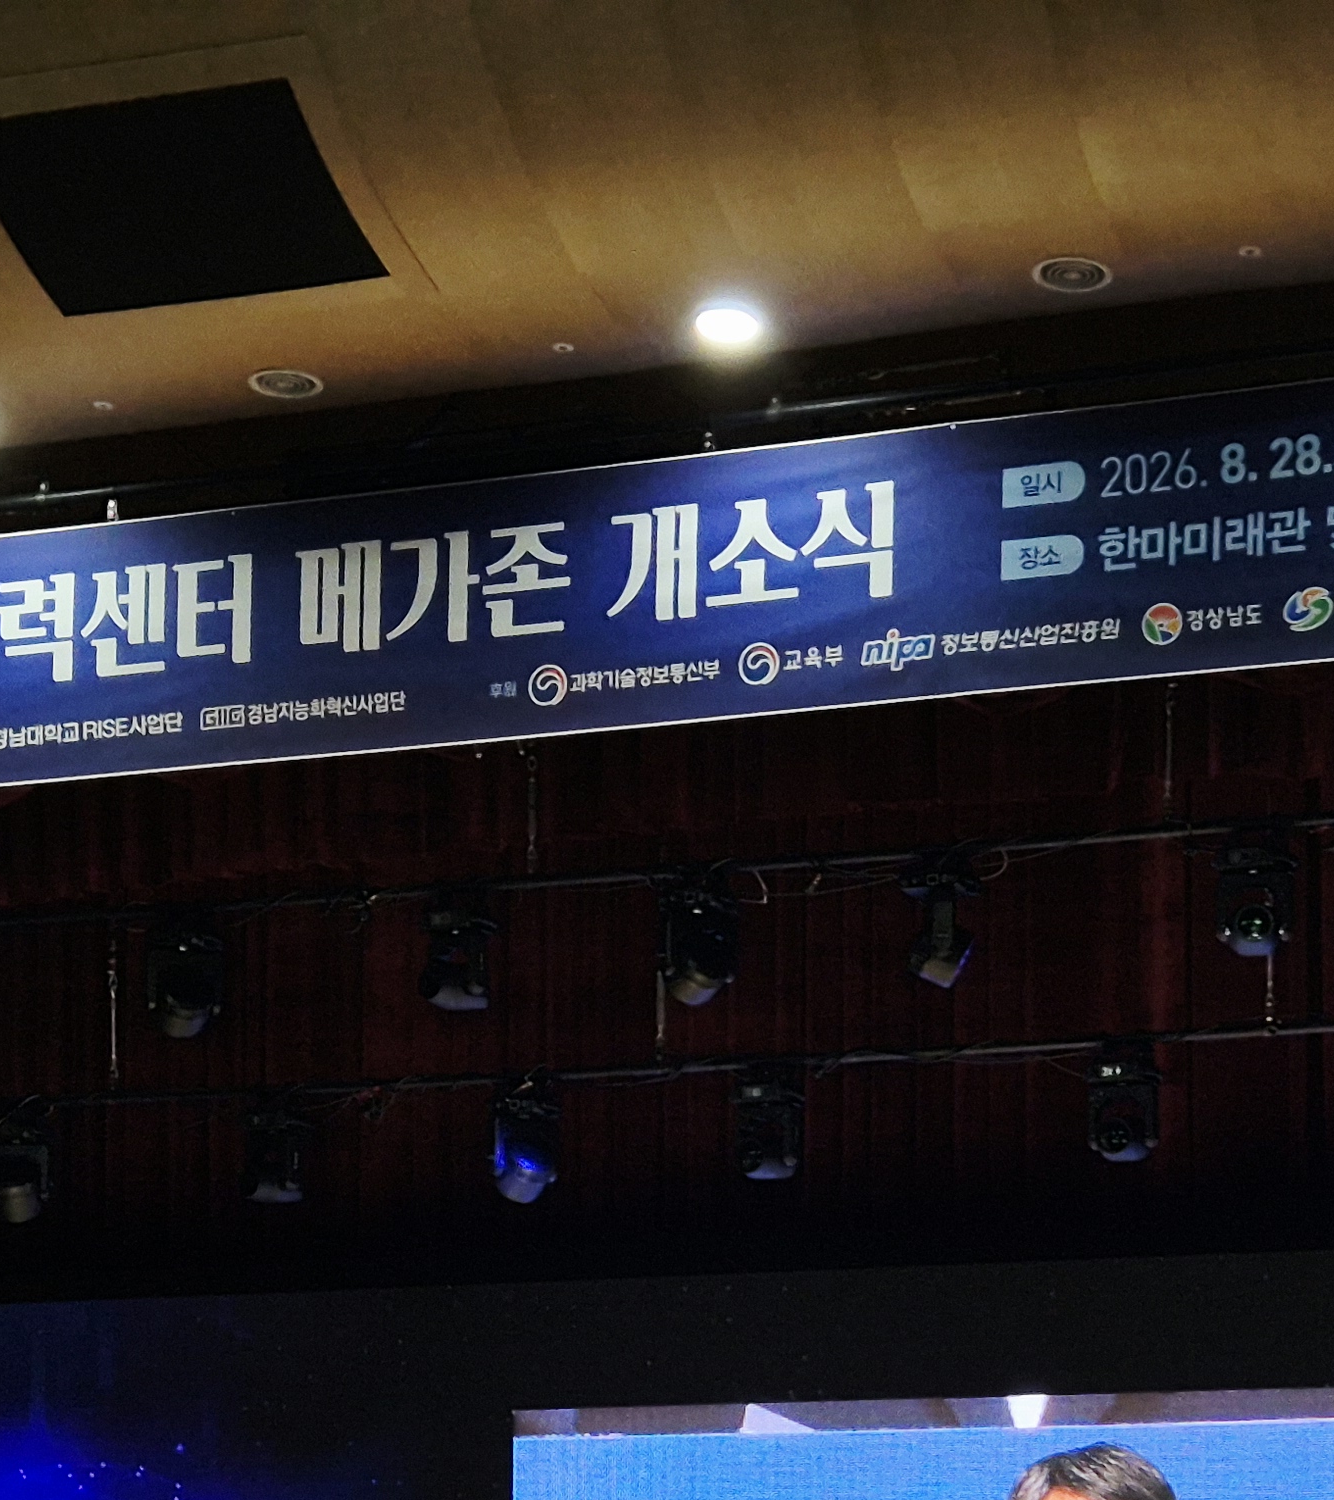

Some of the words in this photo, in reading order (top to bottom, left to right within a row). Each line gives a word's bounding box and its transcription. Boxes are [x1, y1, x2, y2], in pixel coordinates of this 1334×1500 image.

[1020, 470, 1063, 498] 일시
[1100, 451, 1208, 500] 2026.
[1220, 443, 1258, 484] 8.
[294, 520, 572, 654] 메가존
[606, 479, 895, 622] 개소식
[1018, 544, 1062, 570] 장소
[1097, 510, 1311, 573] 한마미래관
[570, 659, 721, 694] 과학기술정보통신부
[783, 645, 844, 671] 교육부
[860, 627, 935, 671] nipa
[940, 616, 1122, 657] 정보통신산업진흥원
[1186, 603, 1263, 631] 경상남도
[82, 711, 184, 741] RISE사업단
[247, 690, 407, 726] 경남지능화혁신사업단
